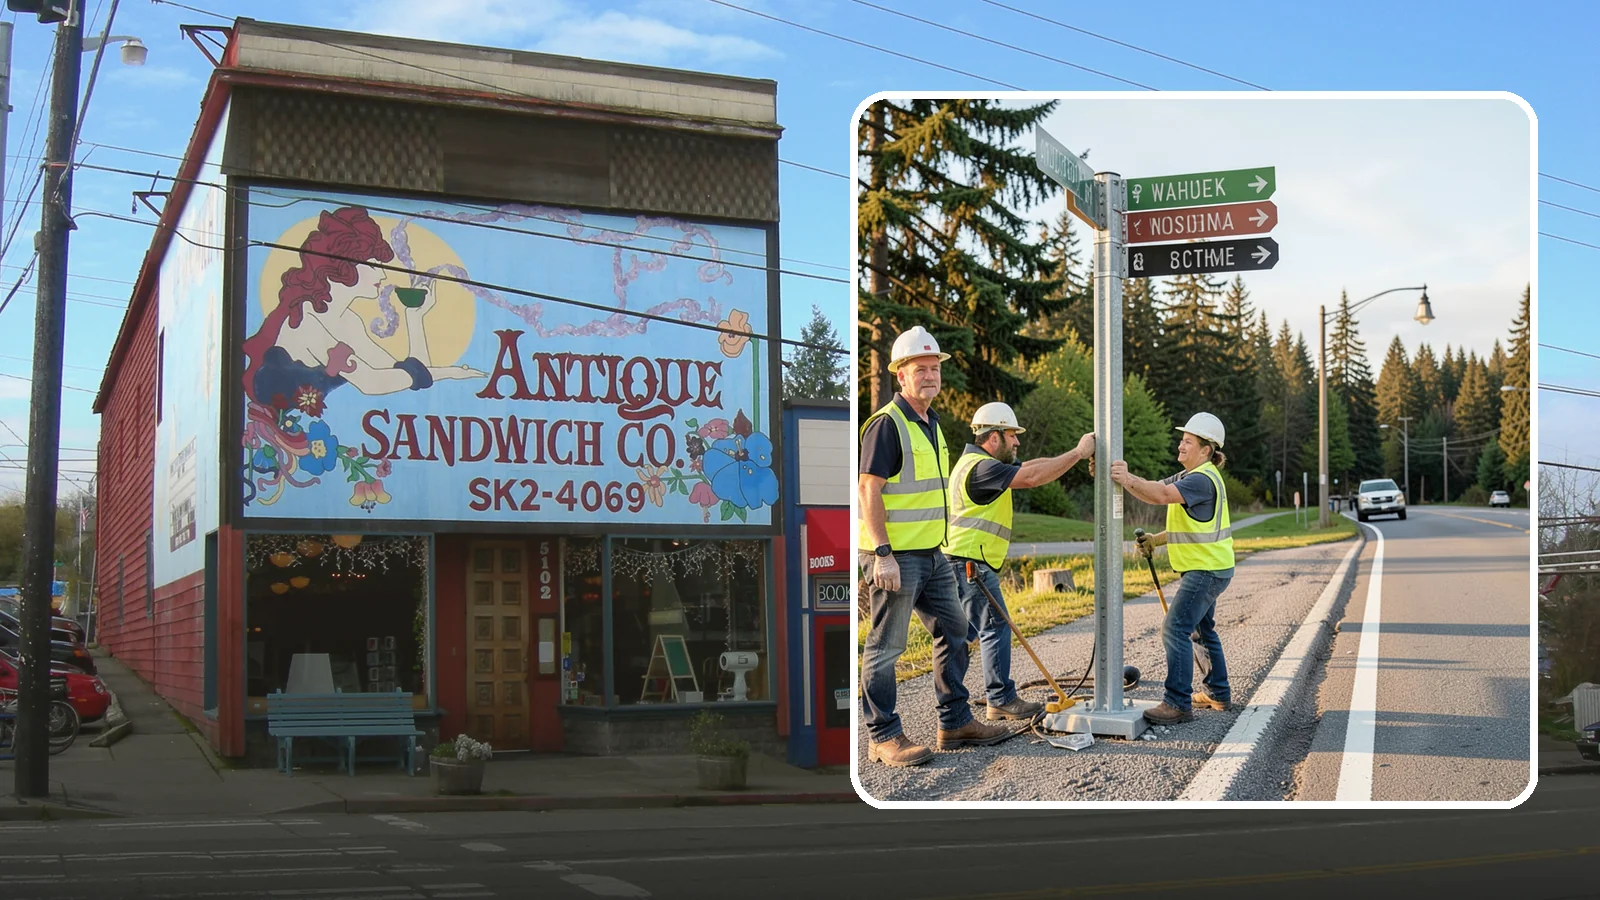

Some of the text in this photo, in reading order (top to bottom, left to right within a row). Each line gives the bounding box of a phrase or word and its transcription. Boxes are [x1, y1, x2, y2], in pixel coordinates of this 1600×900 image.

[475, 329, 724, 421] ANTIQUE
[361, 408, 685, 469] SANDWICH CO.
[469, 477, 646, 513] SK2-4069
[540, 542, 552, 599] 5102
[809, 555, 835, 569] BOOKS
